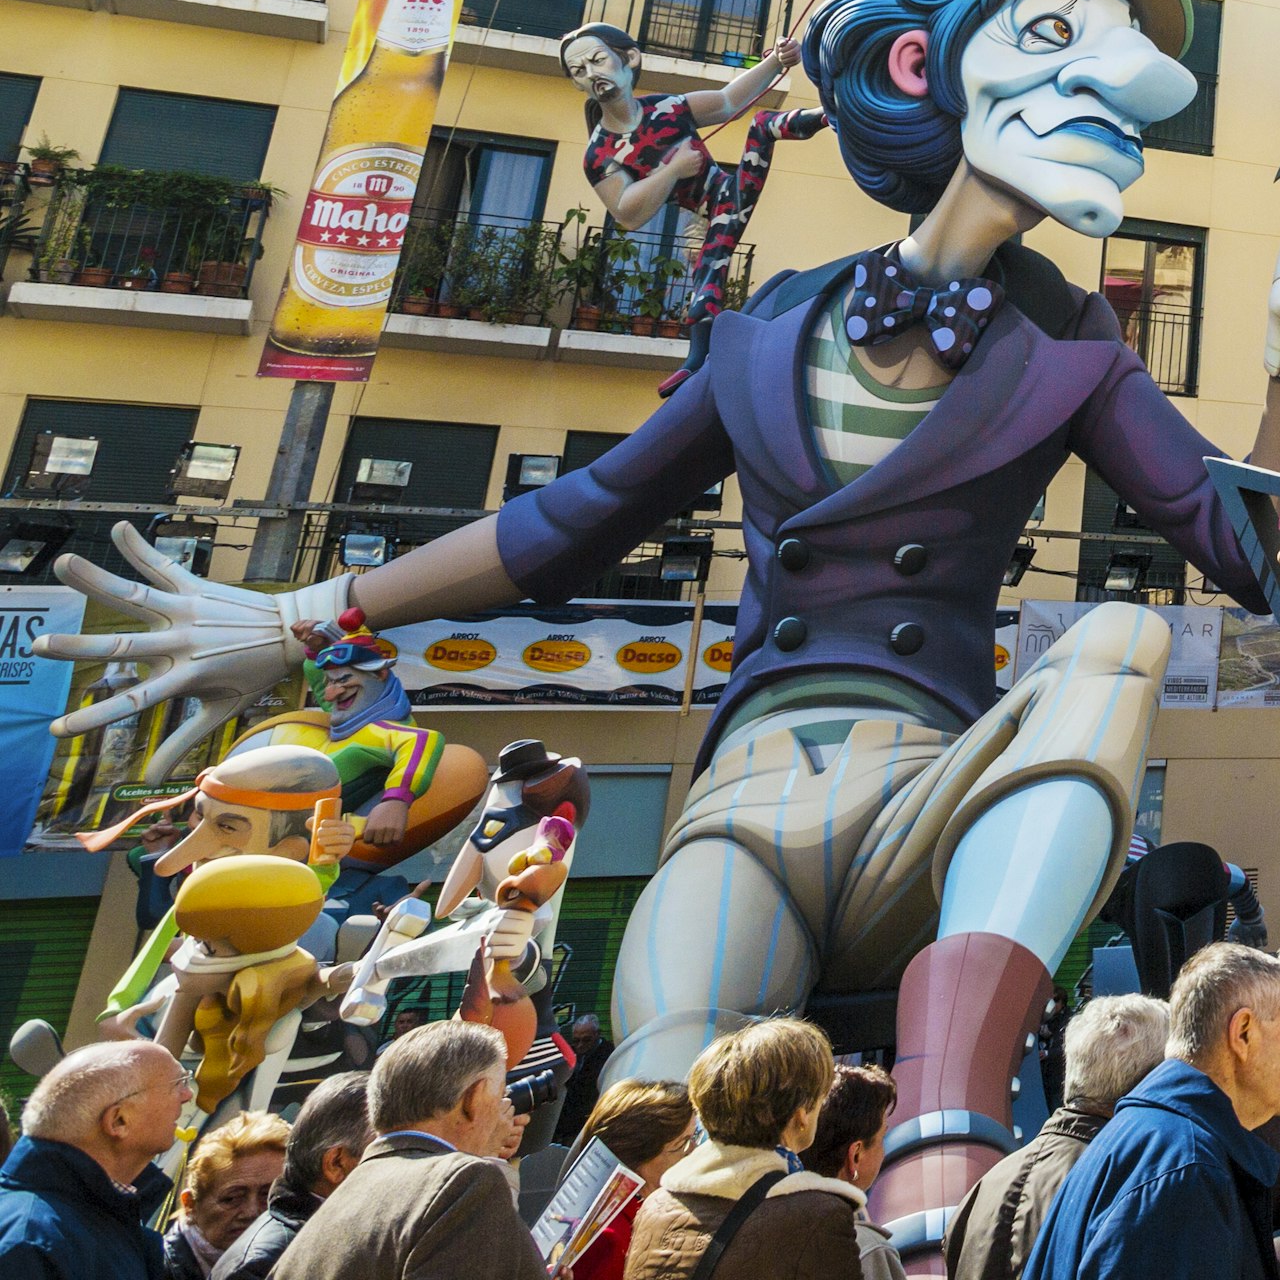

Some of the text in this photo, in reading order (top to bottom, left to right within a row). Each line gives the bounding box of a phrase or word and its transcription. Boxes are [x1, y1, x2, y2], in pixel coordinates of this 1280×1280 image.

[332, 161, 370, 182] CINCO
[304, 263, 346, 294] CERVEZA
[330, 268, 376, 277] ORIGINAL
[0, 615, 45, 658] AS
[432, 646, 491, 661] Dacsa
[530, 647, 585, 661] Dacsa
[623, 648, 676, 663] Dacsa
[0, 662, 36, 678] RISPS
